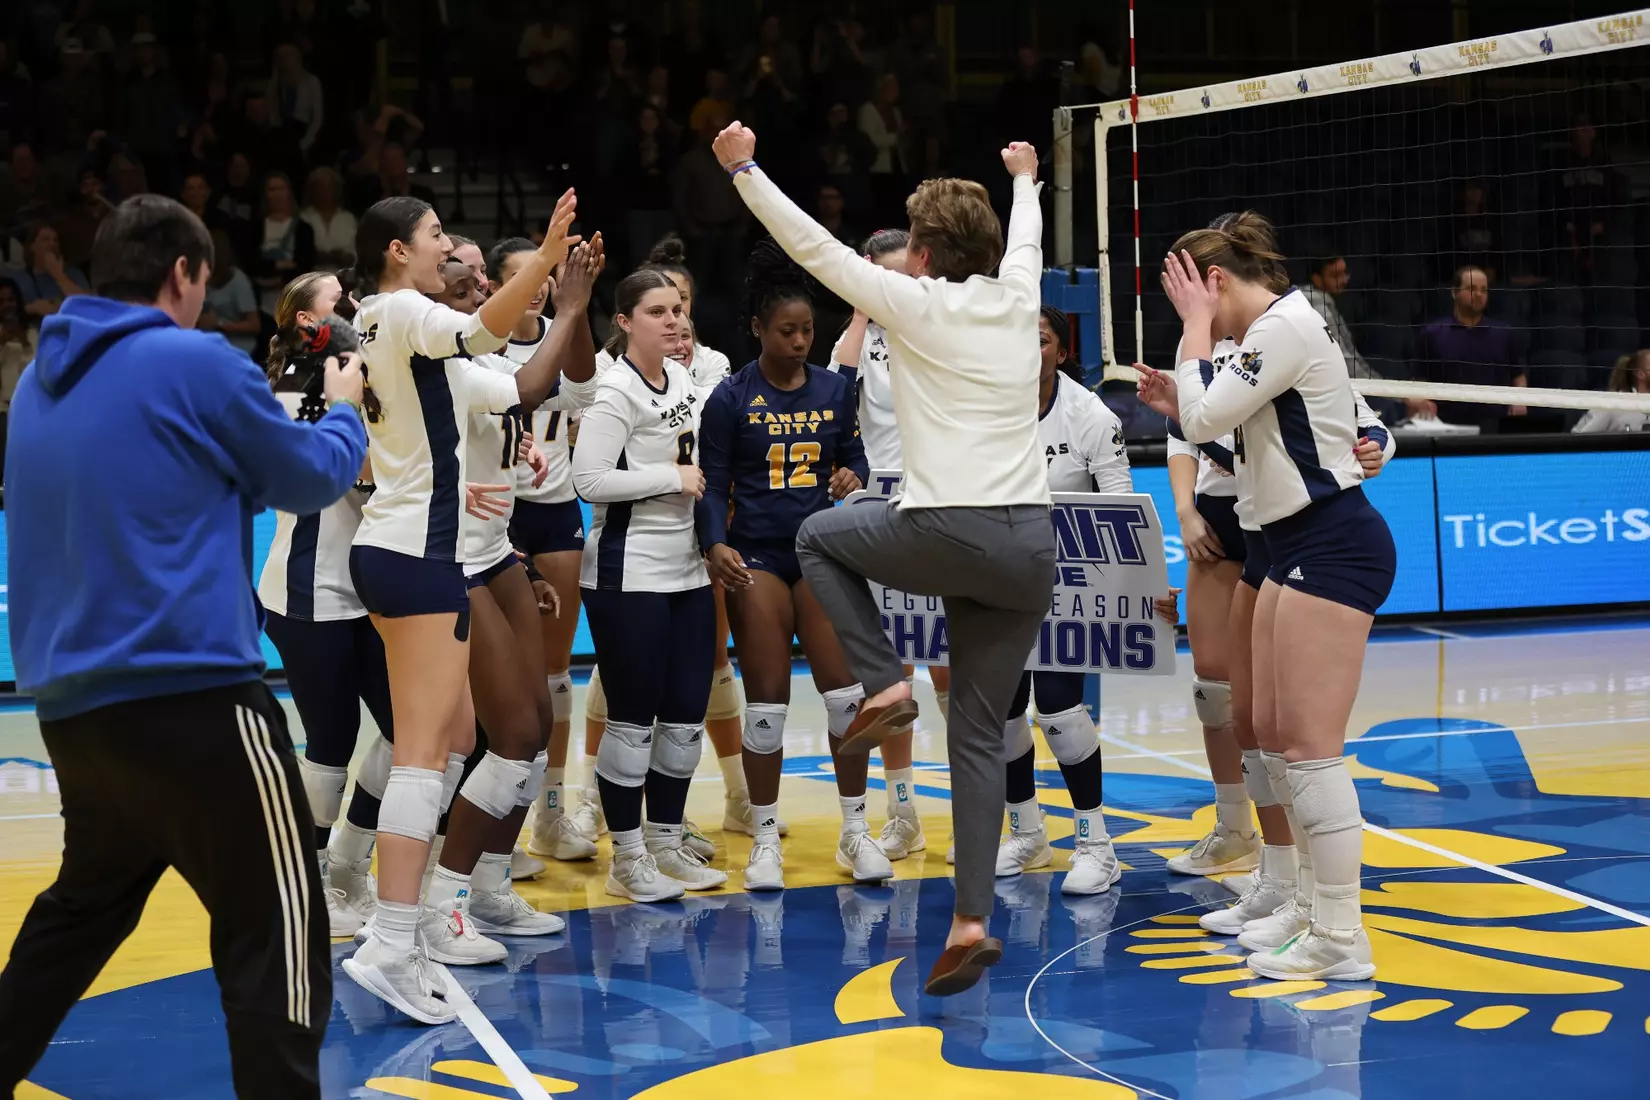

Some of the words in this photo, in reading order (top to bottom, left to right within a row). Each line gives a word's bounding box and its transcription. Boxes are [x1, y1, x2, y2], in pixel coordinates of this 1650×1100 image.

[1229, 363, 1258, 387] ROOS
[748, 410, 834, 424] KANSAS
[768, 422, 820, 435] CITY
[766, 441, 822, 490] 12
[1051, 594, 1154, 620] EASON
